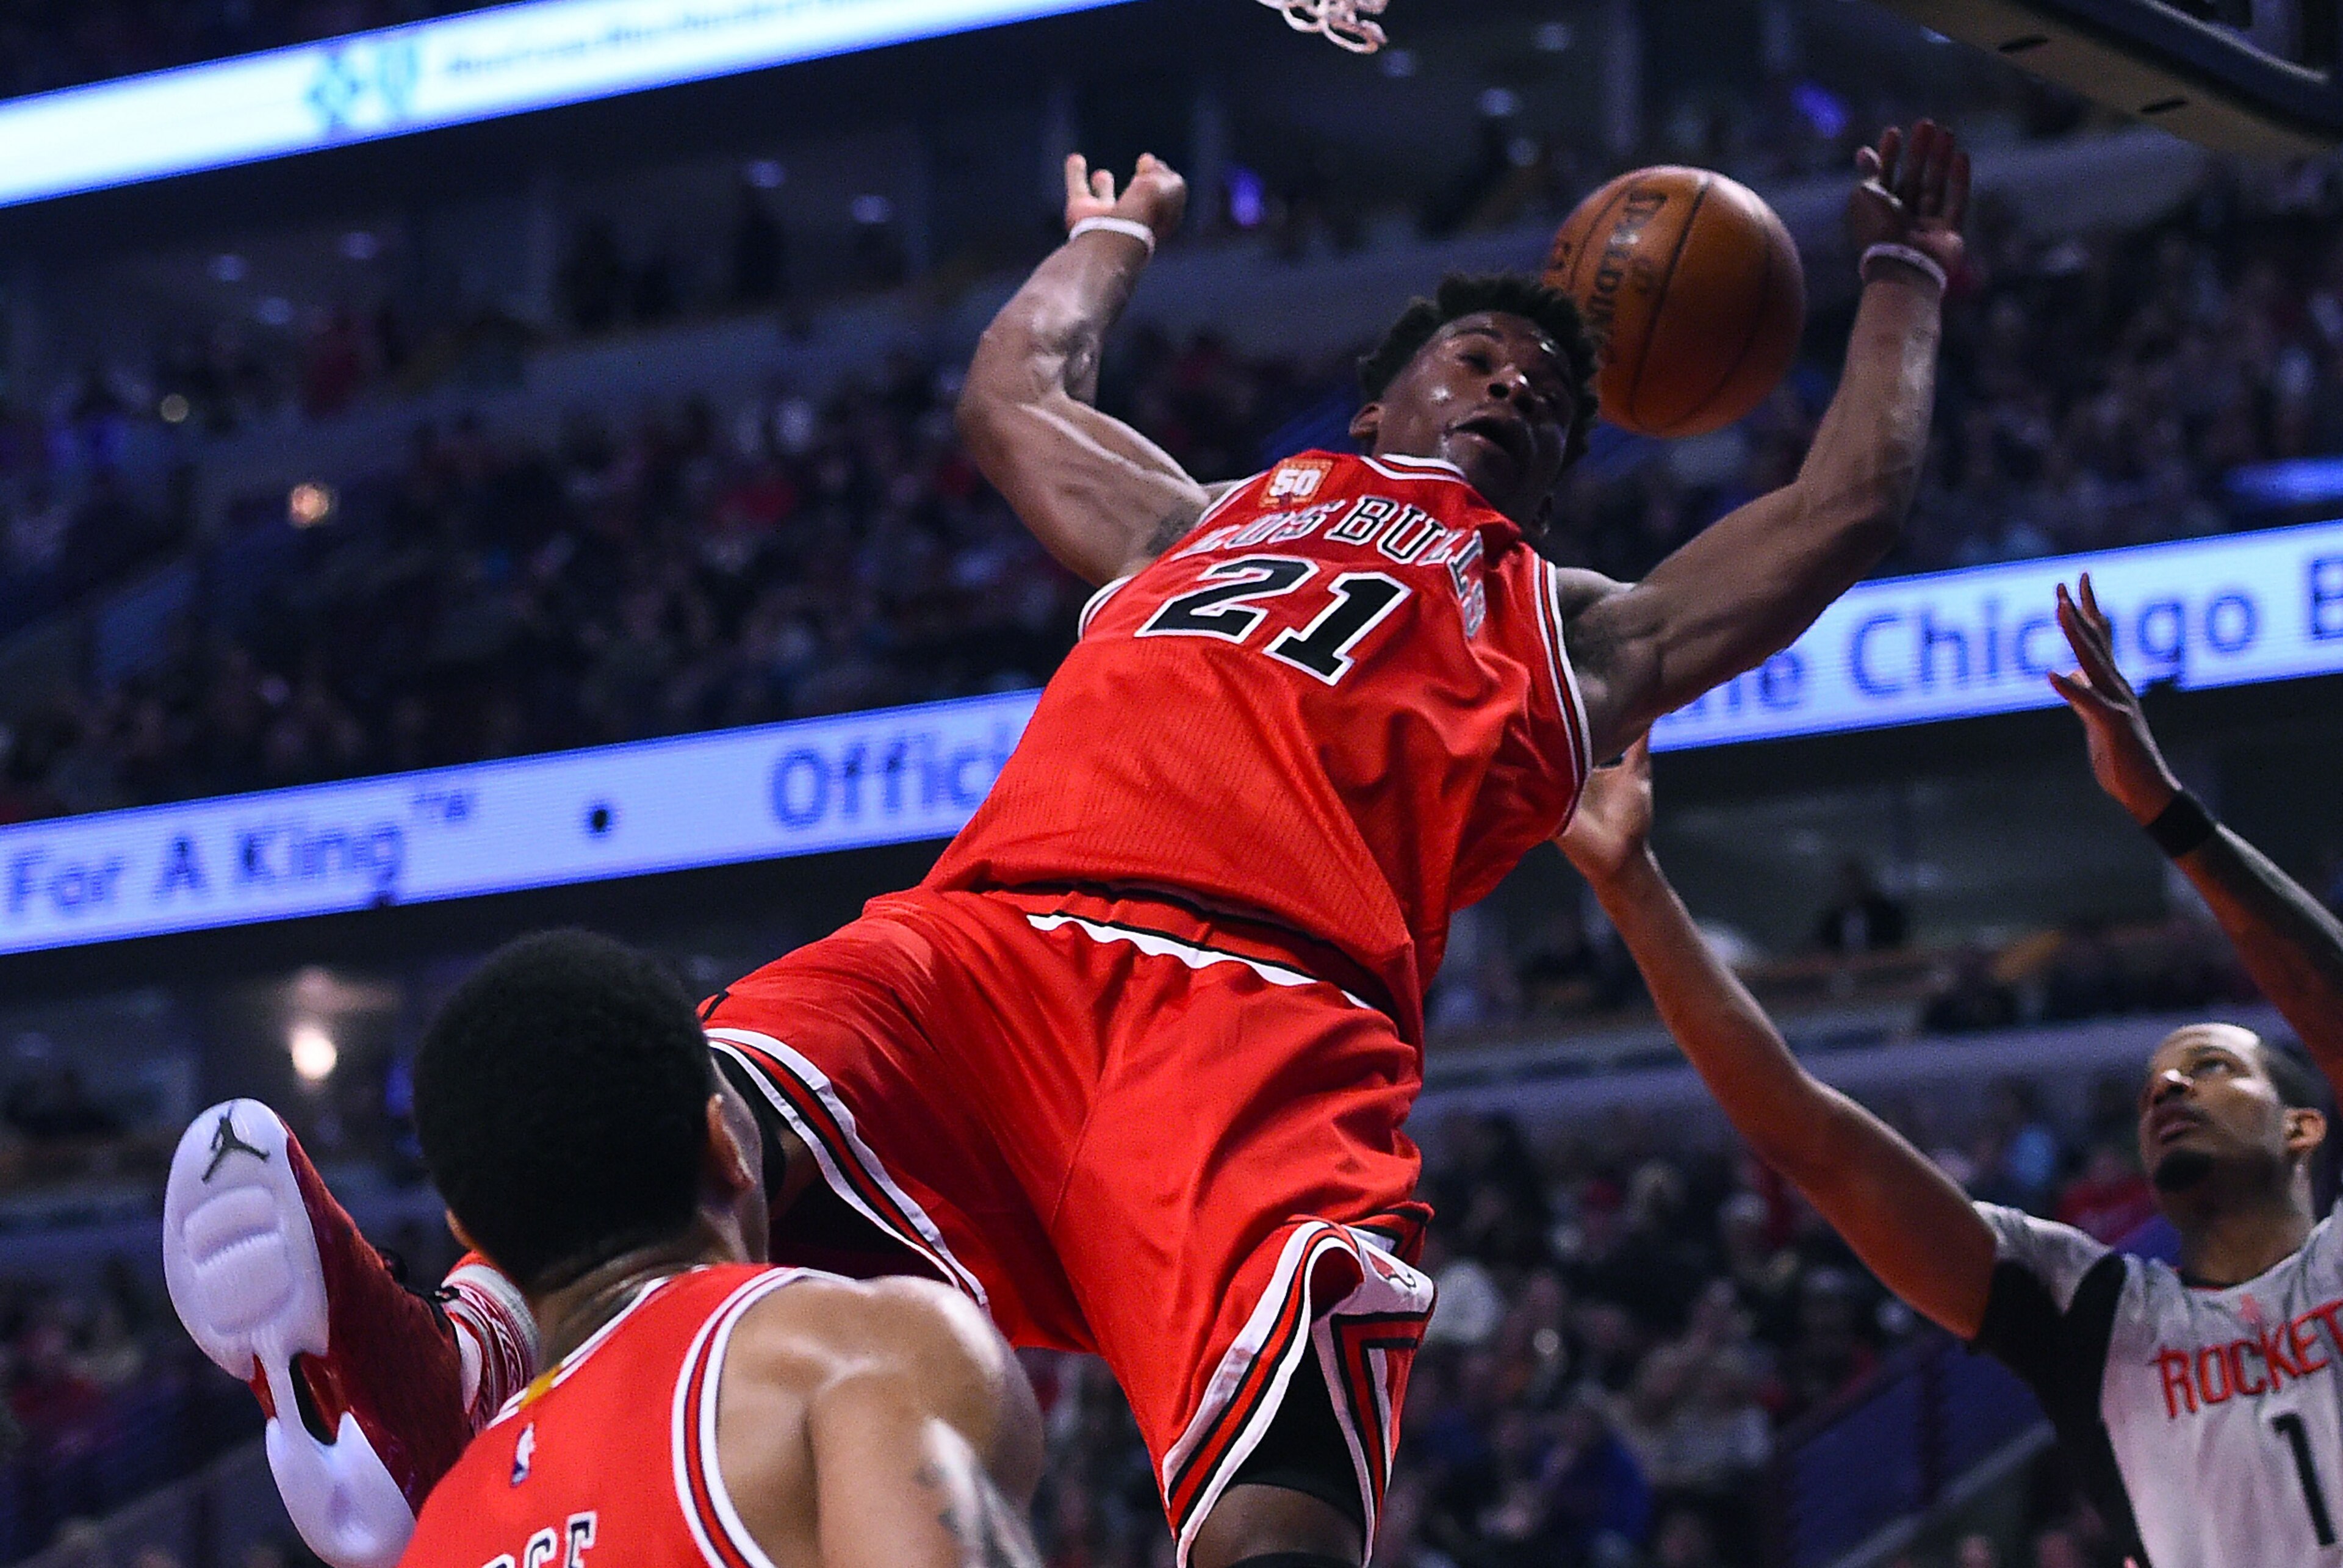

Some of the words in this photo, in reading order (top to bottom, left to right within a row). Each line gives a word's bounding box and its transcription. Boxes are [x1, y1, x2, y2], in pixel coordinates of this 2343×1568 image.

[1269, 467, 1322, 498] 50
[1134, 553, 1413, 687] 21
[1323, 494, 1486, 638] BULLS
[1850, 592, 2260, 697] Chicgo
[7, 849, 126, 919] For
[153, 832, 209, 901] A
[2271, 1411, 2336, 1547] 1
